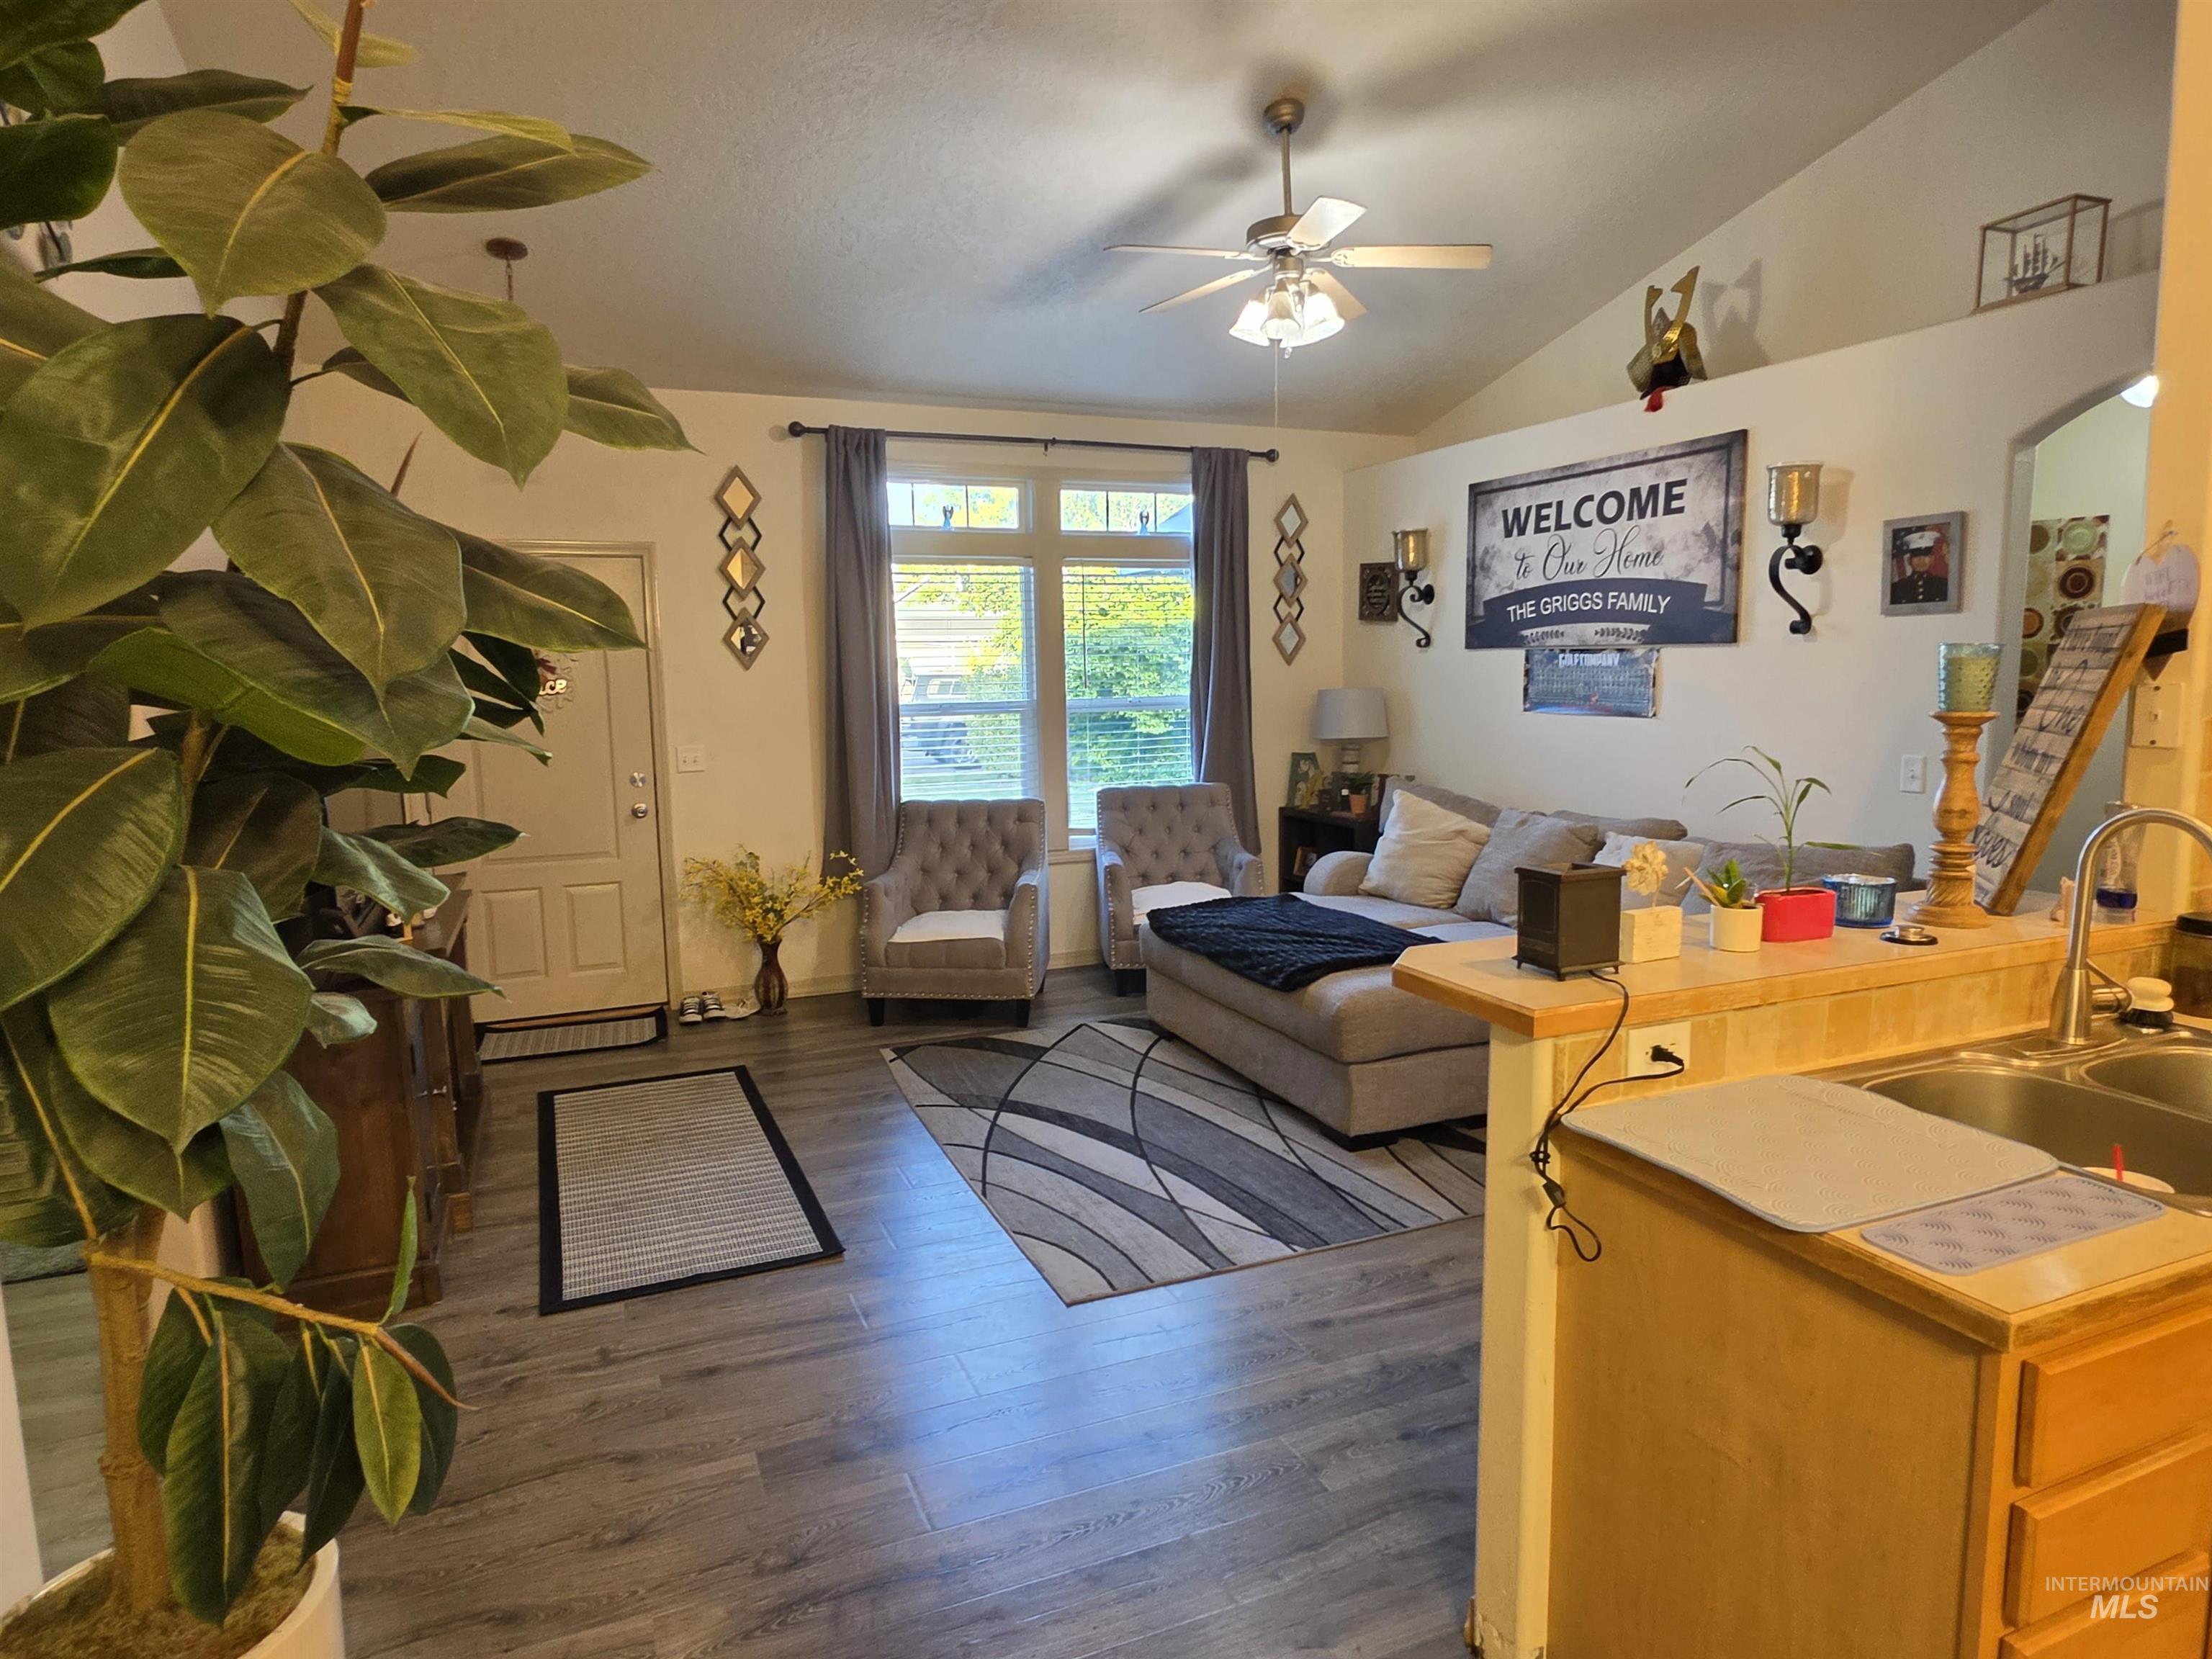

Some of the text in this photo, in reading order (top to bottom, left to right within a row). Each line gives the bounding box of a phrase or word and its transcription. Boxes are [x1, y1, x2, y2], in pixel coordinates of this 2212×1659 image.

[1502, 478, 1689, 539] WELCOME
[1514, 525, 1664, 581] to Our Home
[1507, 592, 1671, 623] THE GRIGGS FAMILY
